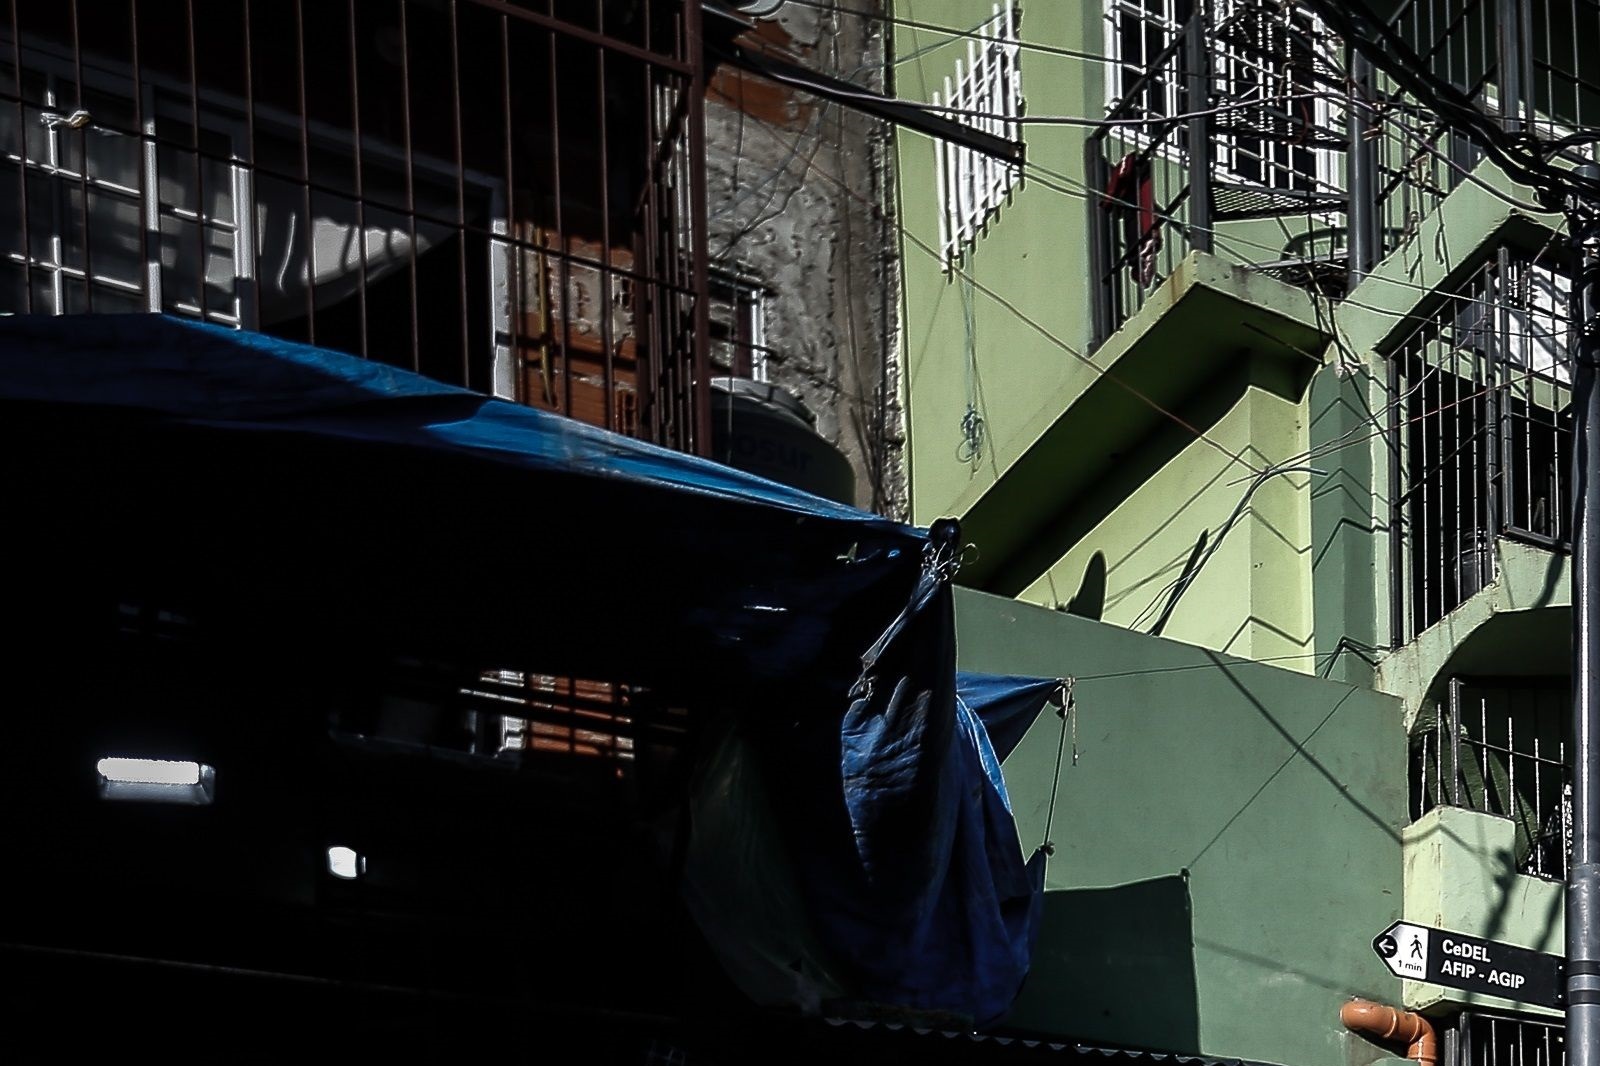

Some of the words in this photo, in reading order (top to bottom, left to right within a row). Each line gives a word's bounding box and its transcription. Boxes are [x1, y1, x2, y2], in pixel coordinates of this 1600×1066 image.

[1442, 939, 1491, 963] CeDEL
[1405, 962, 1422, 972] min
[1440, 959, 1476, 979] AFIP
[1487, 970, 1526, 989] AGIP
